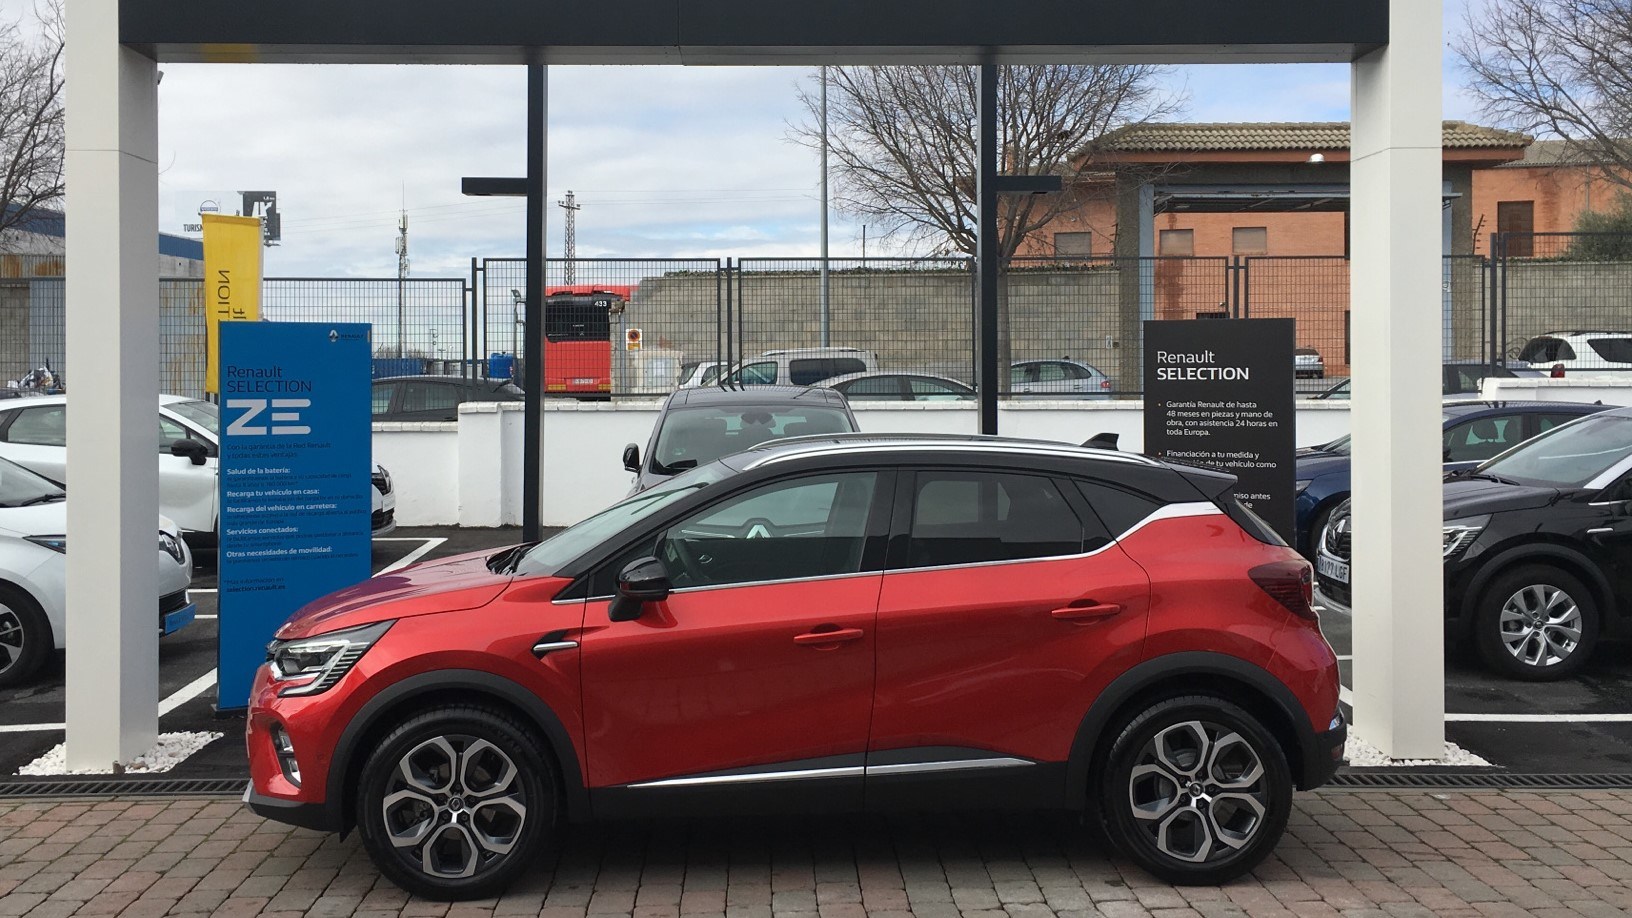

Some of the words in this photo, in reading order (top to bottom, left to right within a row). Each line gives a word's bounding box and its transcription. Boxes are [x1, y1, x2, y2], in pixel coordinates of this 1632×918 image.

[1157, 350, 1215, 364] Renault
[227, 366, 282, 378] Renault
[1157, 368, 1250, 380] SELECTION
[226, 380, 312, 393] SELECTION
[226, 399, 312, 436] ZE
[1211, 411, 1234, 419] piezas
[1184, 429, 1210, 437] Europa.
[1225, 460, 1254, 468] vehículo
[258, 526, 298, 534] conectados:
[247, 548, 287, 557] necesidades
[298, 546, 332, 554] movilidad:
